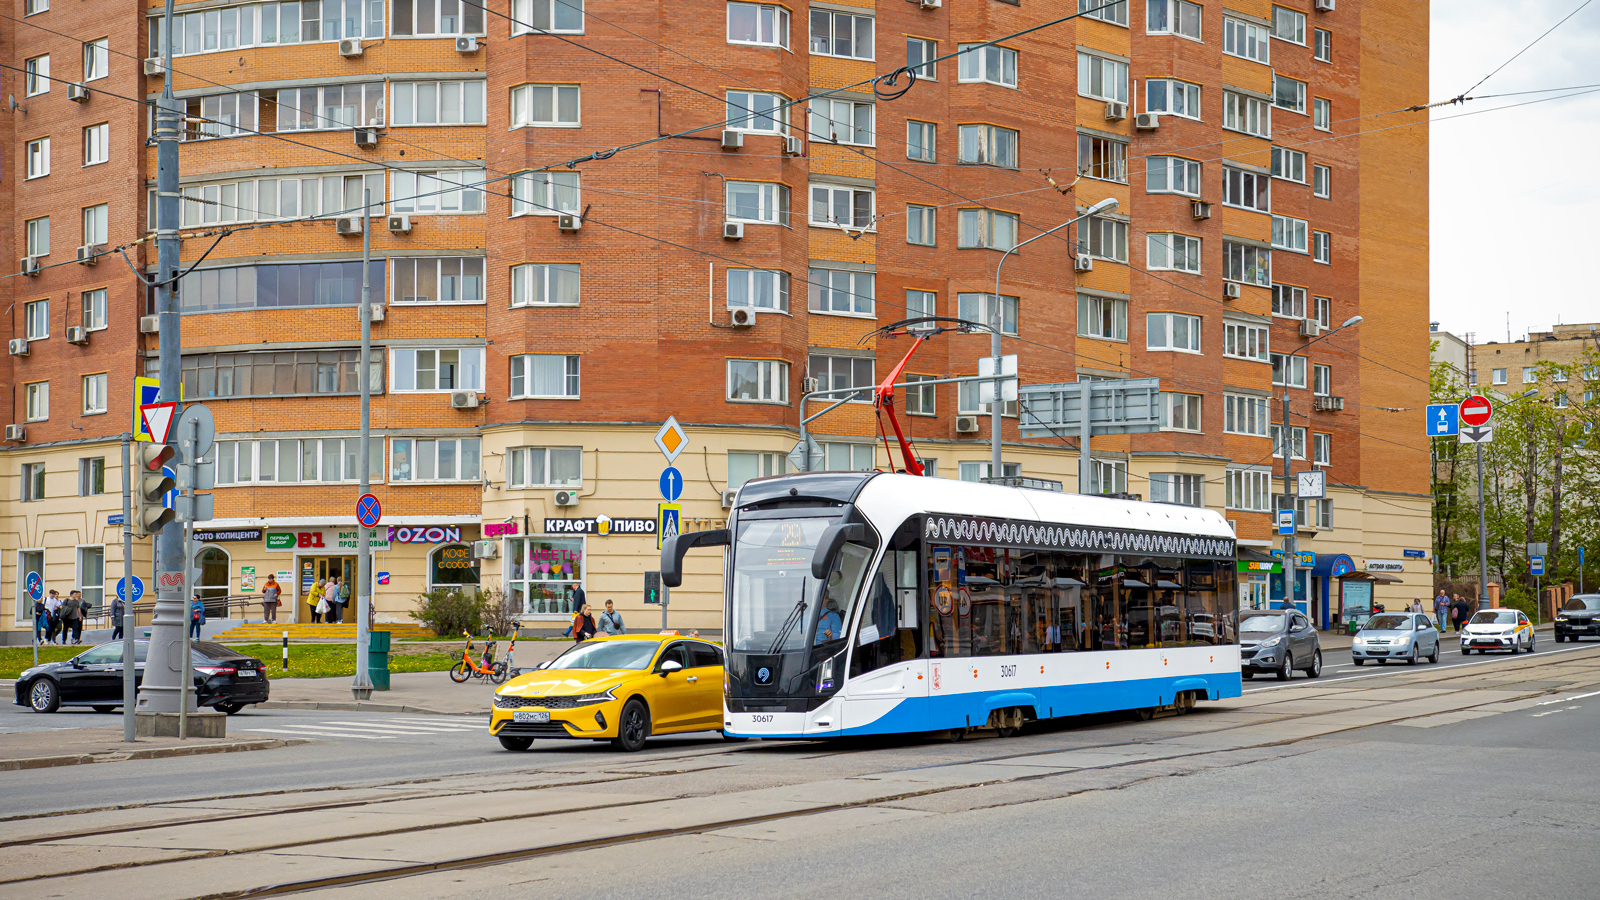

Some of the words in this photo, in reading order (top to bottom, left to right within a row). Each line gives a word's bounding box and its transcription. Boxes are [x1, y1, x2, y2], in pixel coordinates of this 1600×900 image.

[485, 523, 517, 537] ЦВЕТЫ
[546, 520, 594, 532] КРАФТ
[615, 520, 655, 532] ПИВО
[215, 531, 259, 540] КОПИЦЕНТР
[339, 530, 377, 539] ВЫГОЙ
[396, 526, 461, 543] OZON
[781, 523, 801, 546] 29
[339, 539, 389, 548] ПРОДОВЫЙ
[442, 548, 470, 559] КОФЕ
[530, 549, 582, 562] ЦВЕТЫ
[438, 561, 445, 569] с
[1248, 561, 1274, 570] SUBWAY
[1001, 664, 1017, 678] 30617
[752, 714, 774, 723] 30617
